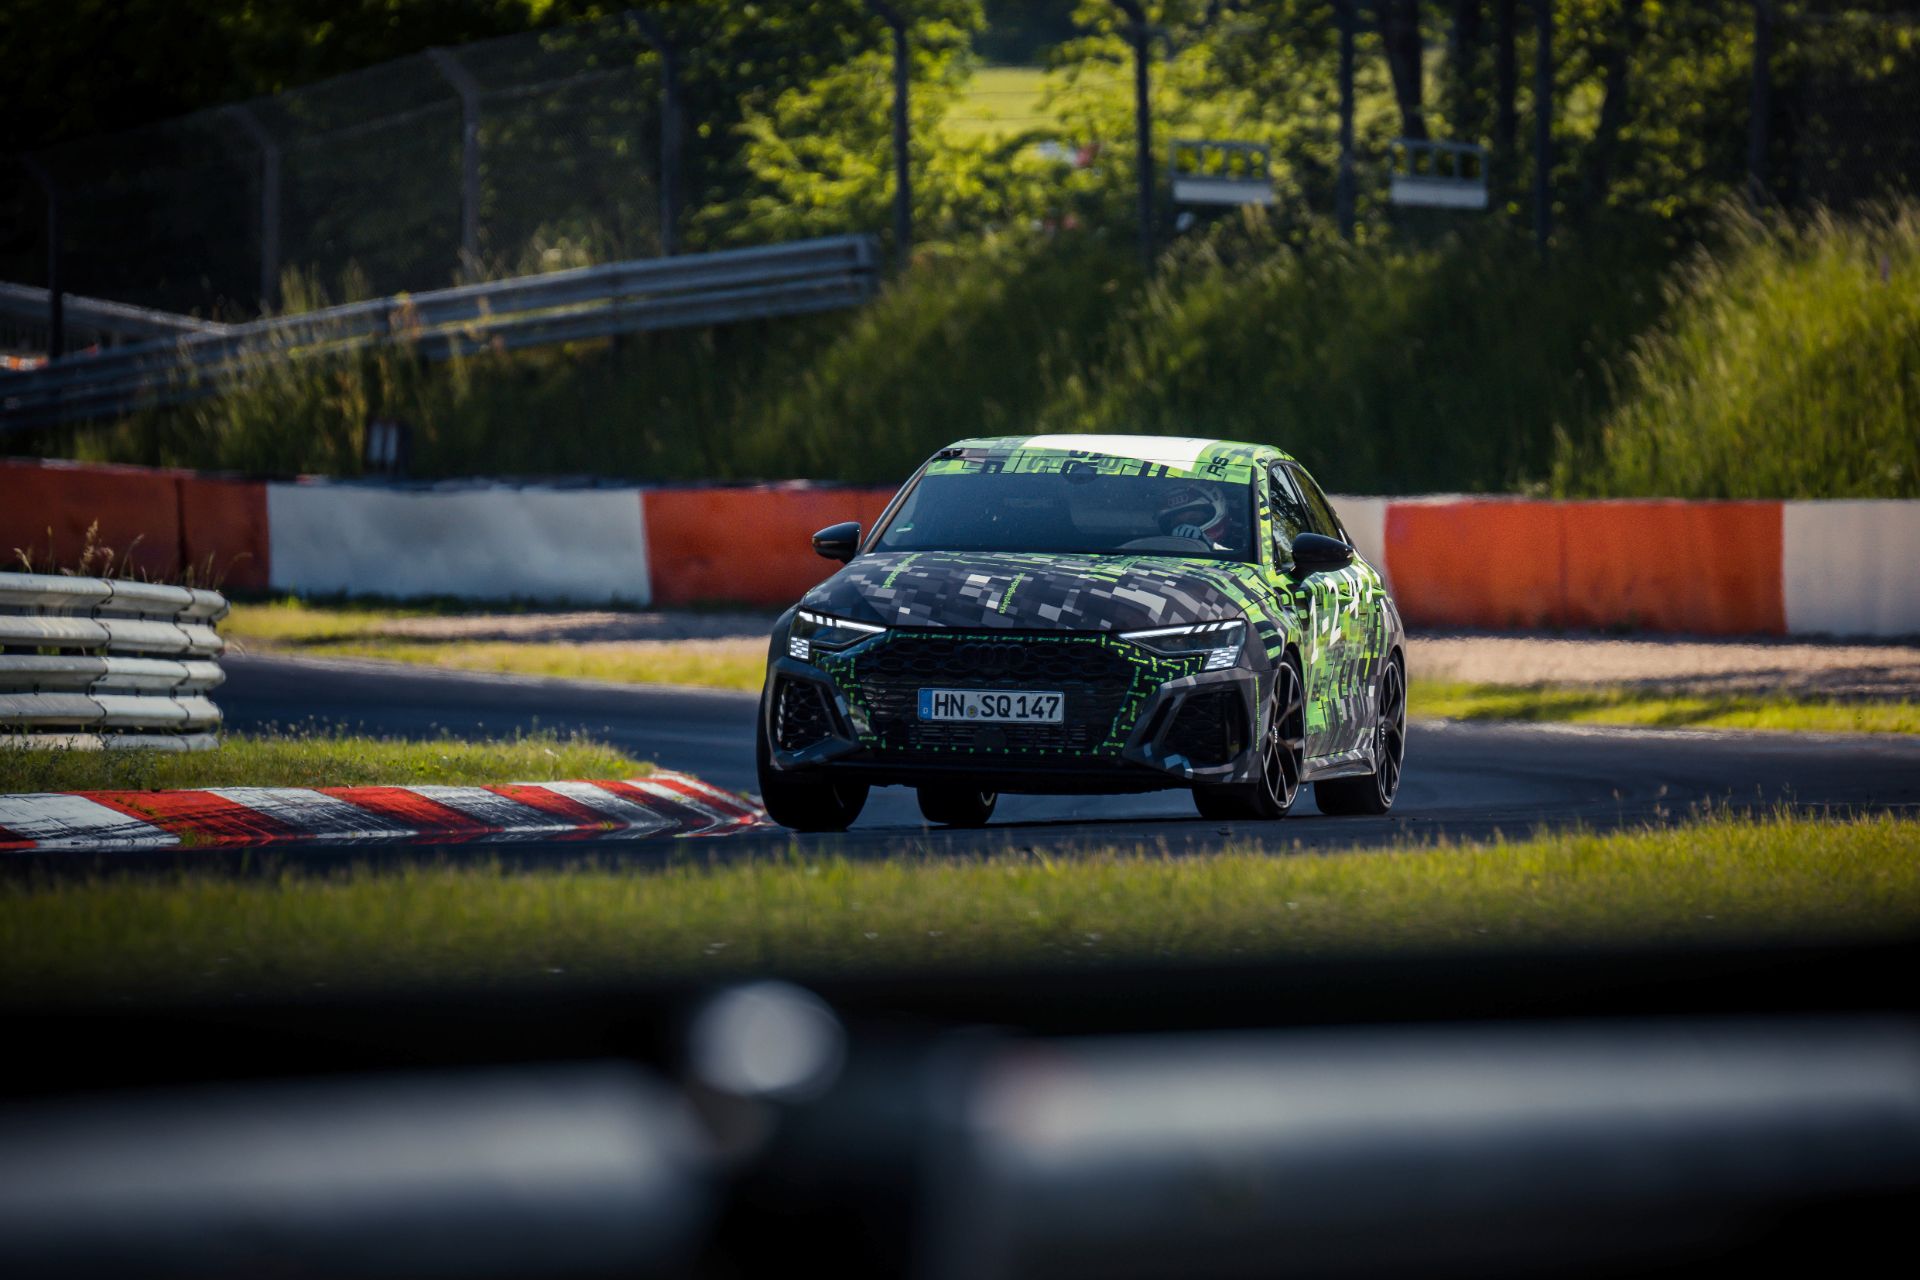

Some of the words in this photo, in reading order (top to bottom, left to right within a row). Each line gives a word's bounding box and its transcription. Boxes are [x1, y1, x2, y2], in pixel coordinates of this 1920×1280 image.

[1206, 456, 1230, 477] RS
[934, 693, 965, 717] HN
[981, 695, 1011, 718] SQ
[1016, 696, 1060, 719] 147
